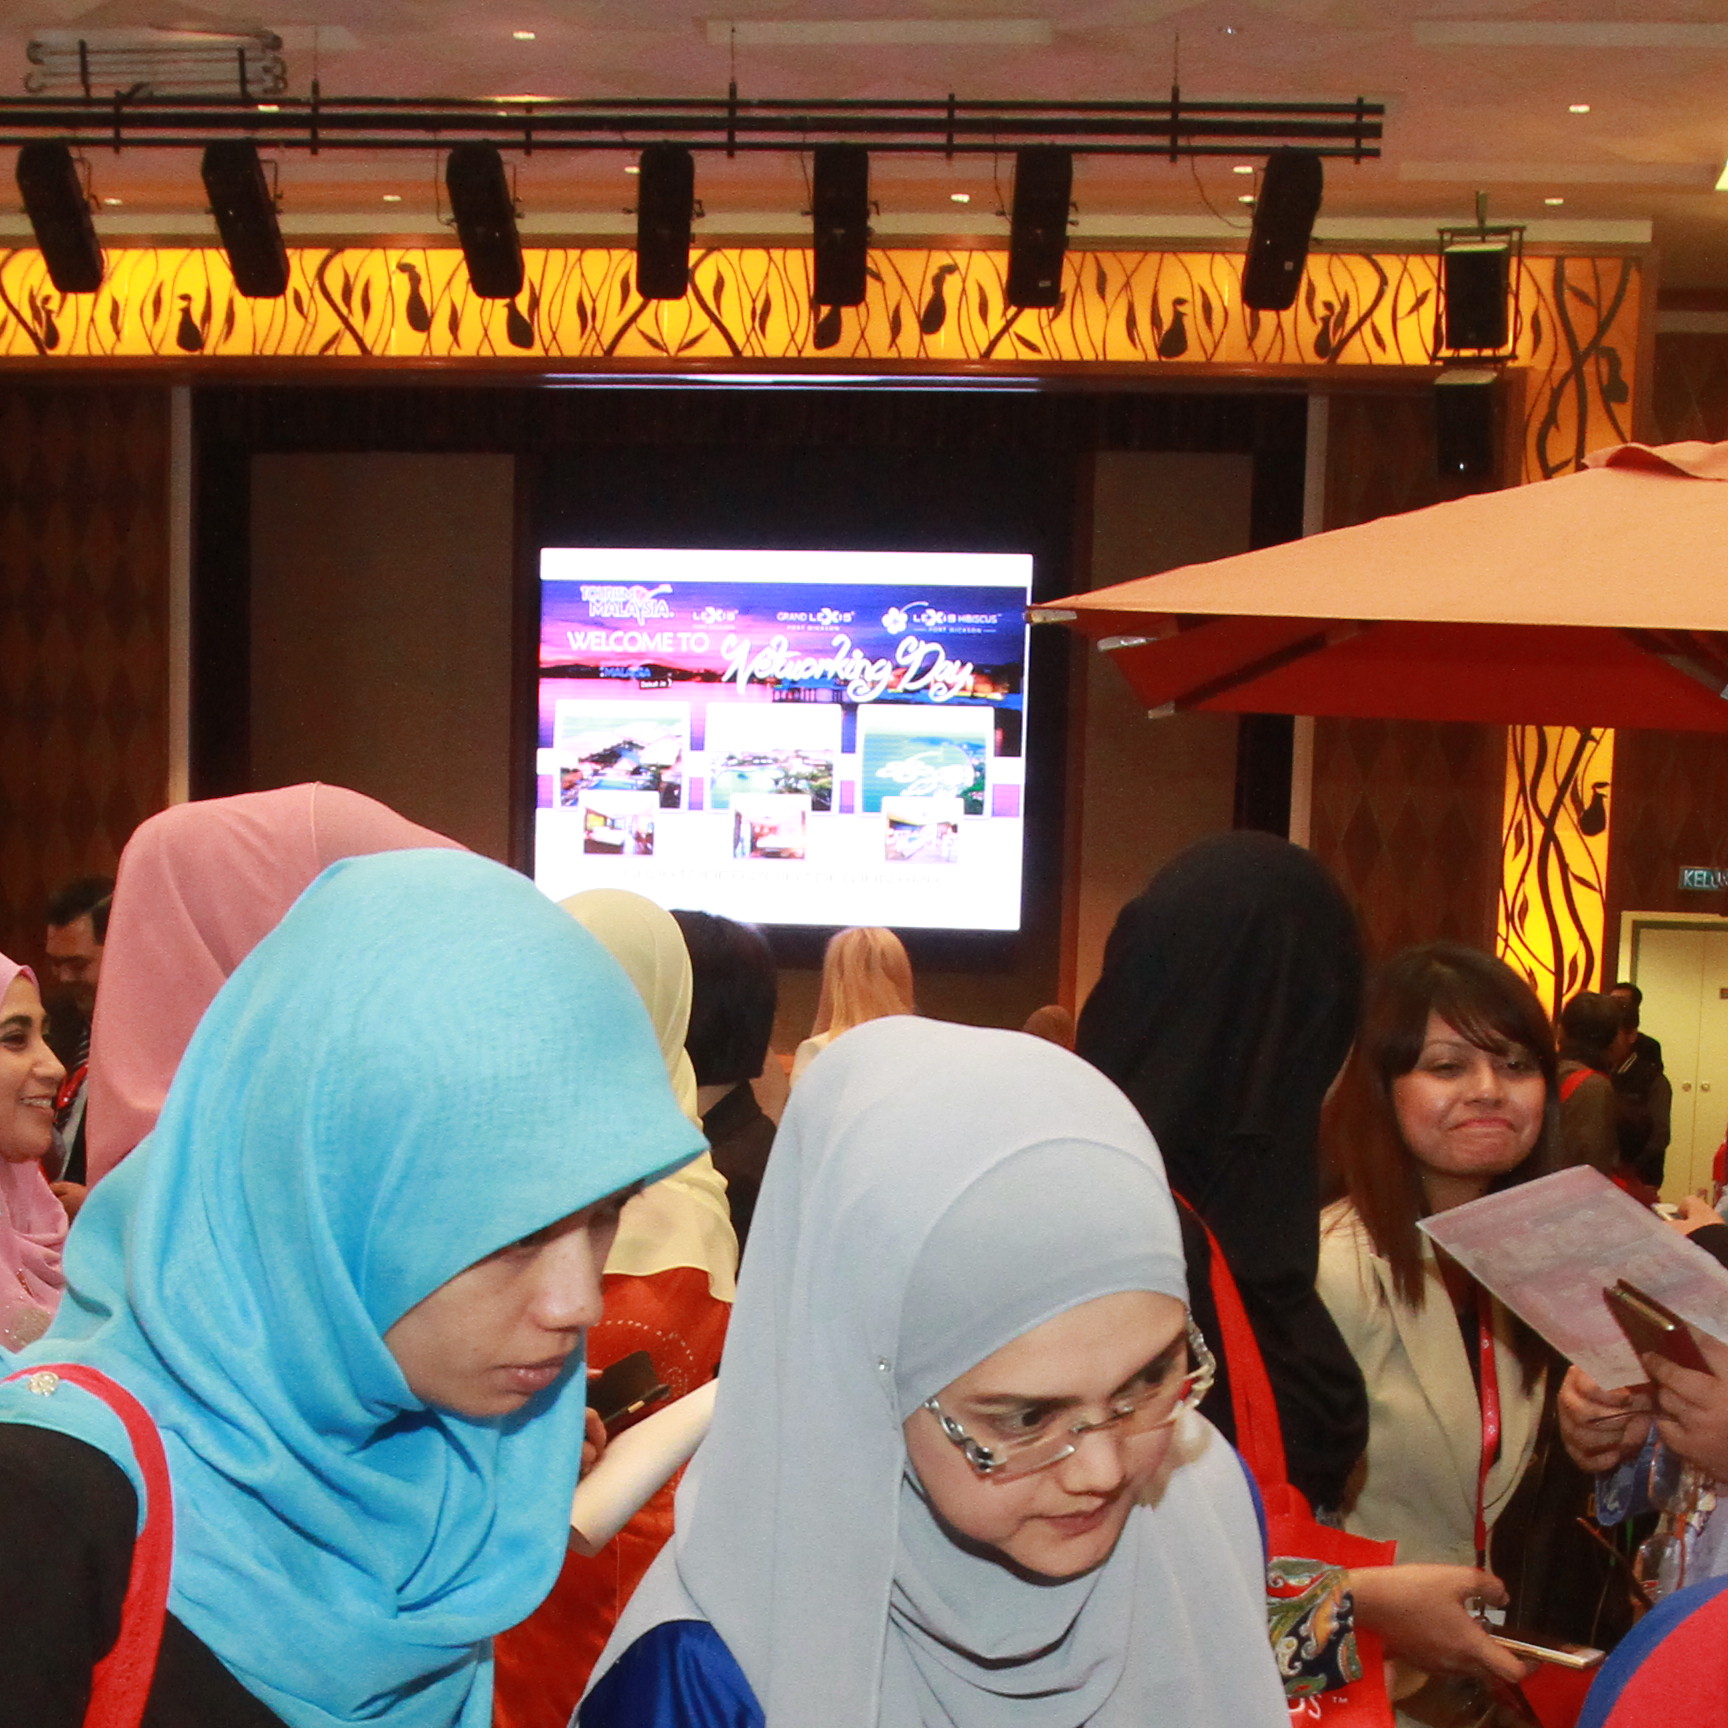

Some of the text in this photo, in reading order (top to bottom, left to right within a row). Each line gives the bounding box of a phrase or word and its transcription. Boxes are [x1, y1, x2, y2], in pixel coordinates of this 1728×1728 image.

[589, 600, 671, 626] MALAYSIA
[777, 608, 852, 625] GRAND LEXIS
[913, 609, 956, 626] LEXIS
[567, 631, 710, 653] WELCOME TO
[721, 634, 974, 702] Networking Day
